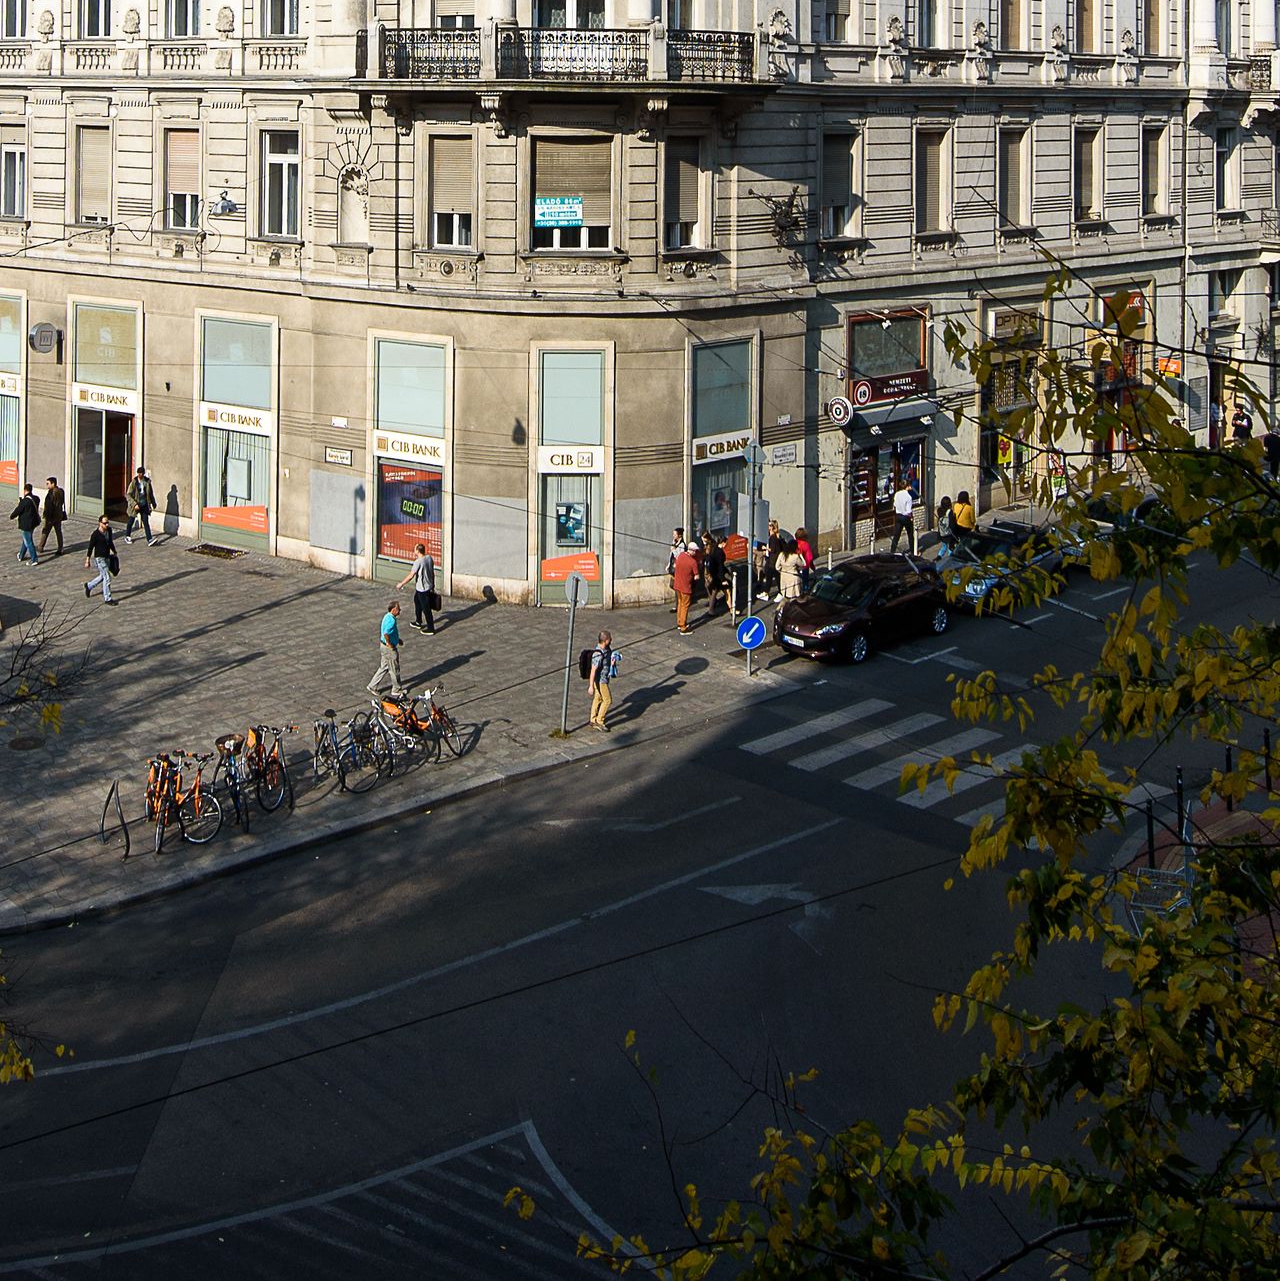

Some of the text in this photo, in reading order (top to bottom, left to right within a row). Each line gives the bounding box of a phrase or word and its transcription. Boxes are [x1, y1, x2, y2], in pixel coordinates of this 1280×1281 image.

[996, 311, 1038, 327] OPTIKA
[90, 392, 129, 406] CIB BANK
[220, 412, 263, 427] CIB BANK
[391, 440, 441, 458] CIB BANK
[709, 437, 750, 456] CIB BANK
[550, 454, 591, 466] CIB 24
